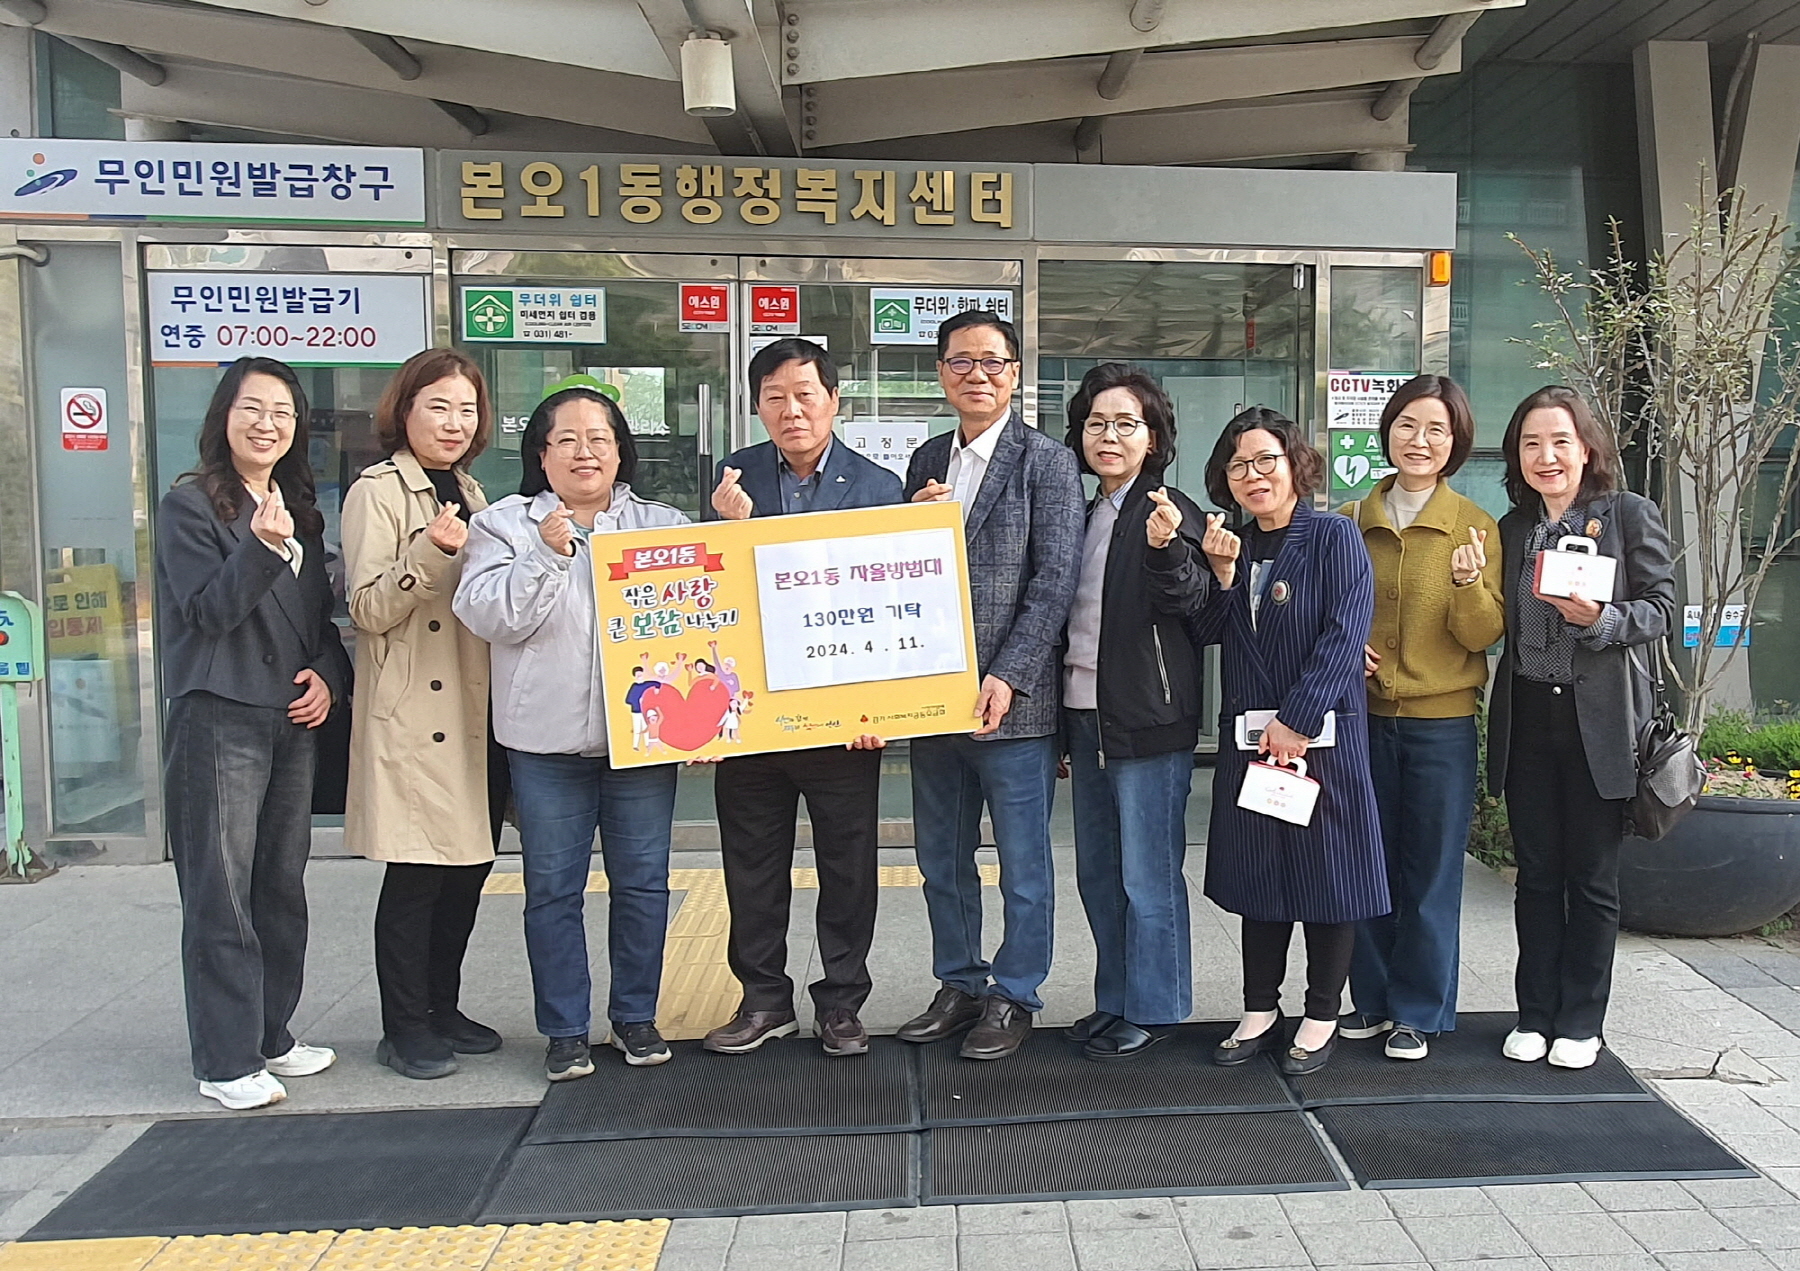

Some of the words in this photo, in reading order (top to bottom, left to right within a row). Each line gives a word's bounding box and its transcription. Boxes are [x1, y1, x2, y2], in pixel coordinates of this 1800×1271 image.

[94, 159, 395, 201] 무인민원발급창구
[171, 285, 361, 314] 무인민원발급기
[518, 293, 561, 306] 무더위
[688, 295, 720, 309] 에스원
[758, 297, 790, 310] 에스원
[520, 310, 555, 320] 미세먼지
[160, 323, 206, 348] 연중
[217, 325, 376, 348] 07:00~22:00
[534, 330, 551, 339] 031)
[1331, 378, 1413, 393] CCTV녹화
[633, 546, 697, 569] 본오1동
[775, 567, 840, 591] 본오1동
[850, 558, 943, 582] 자율방범대
[74, 591, 107, 610] 인해
[624, 585, 655, 606] 작은
[662, 577, 715, 607] 사랑
[608, 617, 626, 639] 큰
[633, 610, 682, 637] 보람
[686, 609, 737, 629] 나누기
[802, 607, 875, 628] 130만원
[885, 602, 922, 619] 기탁
